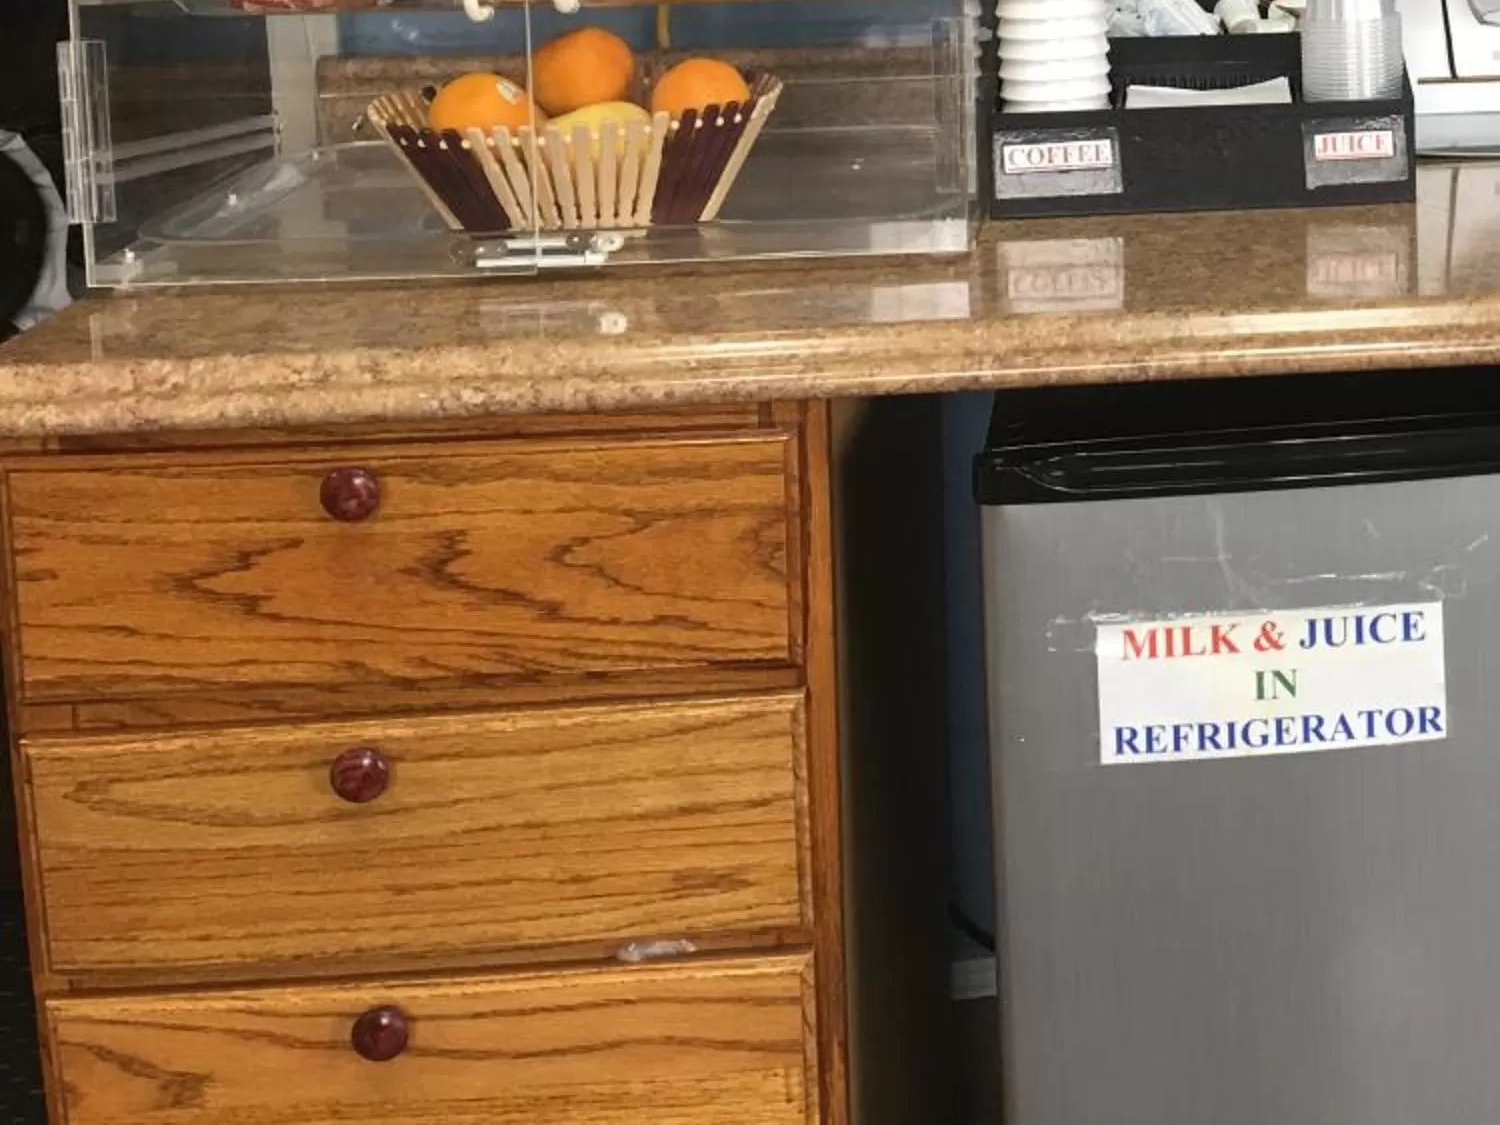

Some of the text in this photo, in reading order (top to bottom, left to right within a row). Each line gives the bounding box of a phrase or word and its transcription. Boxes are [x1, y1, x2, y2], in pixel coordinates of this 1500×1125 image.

[1008, 143, 1110, 166] COFFEE
[1317, 133, 1387, 153] JUICE
[1121, 611, 1426, 660] MILK & JUICE
[1252, 669, 1299, 701] IN
[1113, 705, 1444, 756] REFRIGERATOR
